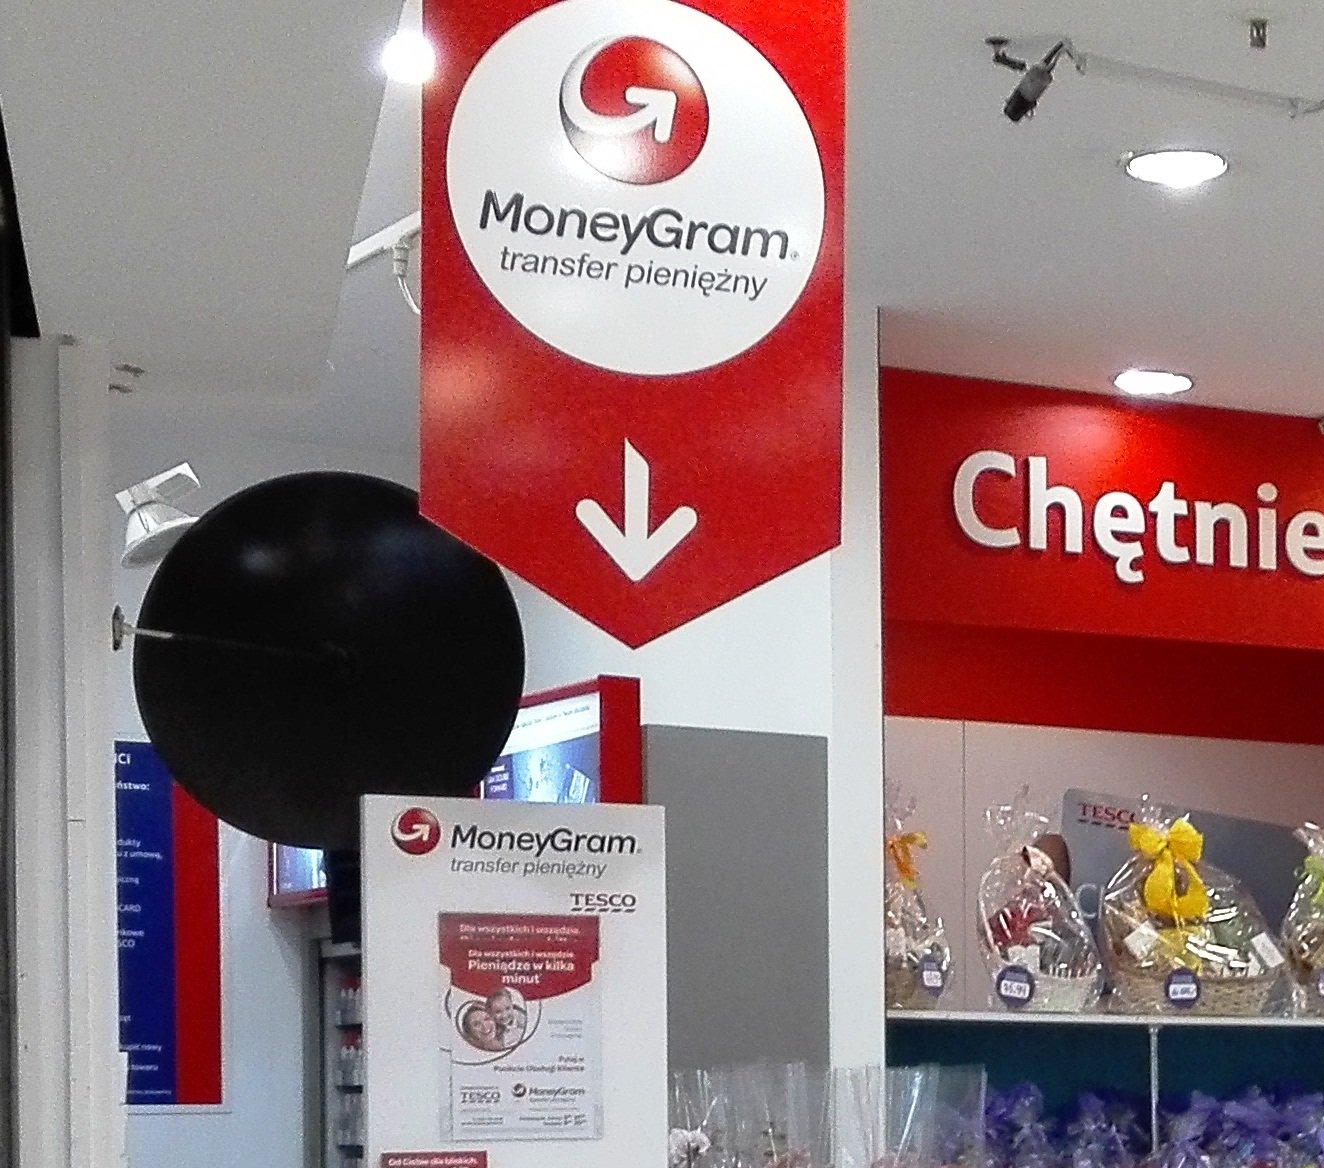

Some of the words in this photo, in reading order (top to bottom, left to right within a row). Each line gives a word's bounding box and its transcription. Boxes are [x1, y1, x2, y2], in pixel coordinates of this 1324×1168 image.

[478, 189, 790, 261] MoneyGram
[499, 246, 618, 281] transfer
[624, 260, 769, 301] pieniężny
[450, 824, 638, 858] MoneyGram
[450, 857, 520, 874] transfer
[522, 860, 608, 879] pieniężny
[569, 892, 637, 909] TESCO
[468, 959, 532, 973] Pieniądze
[533, 962, 544, 971] w
[545, 959, 575, 971] kilka
